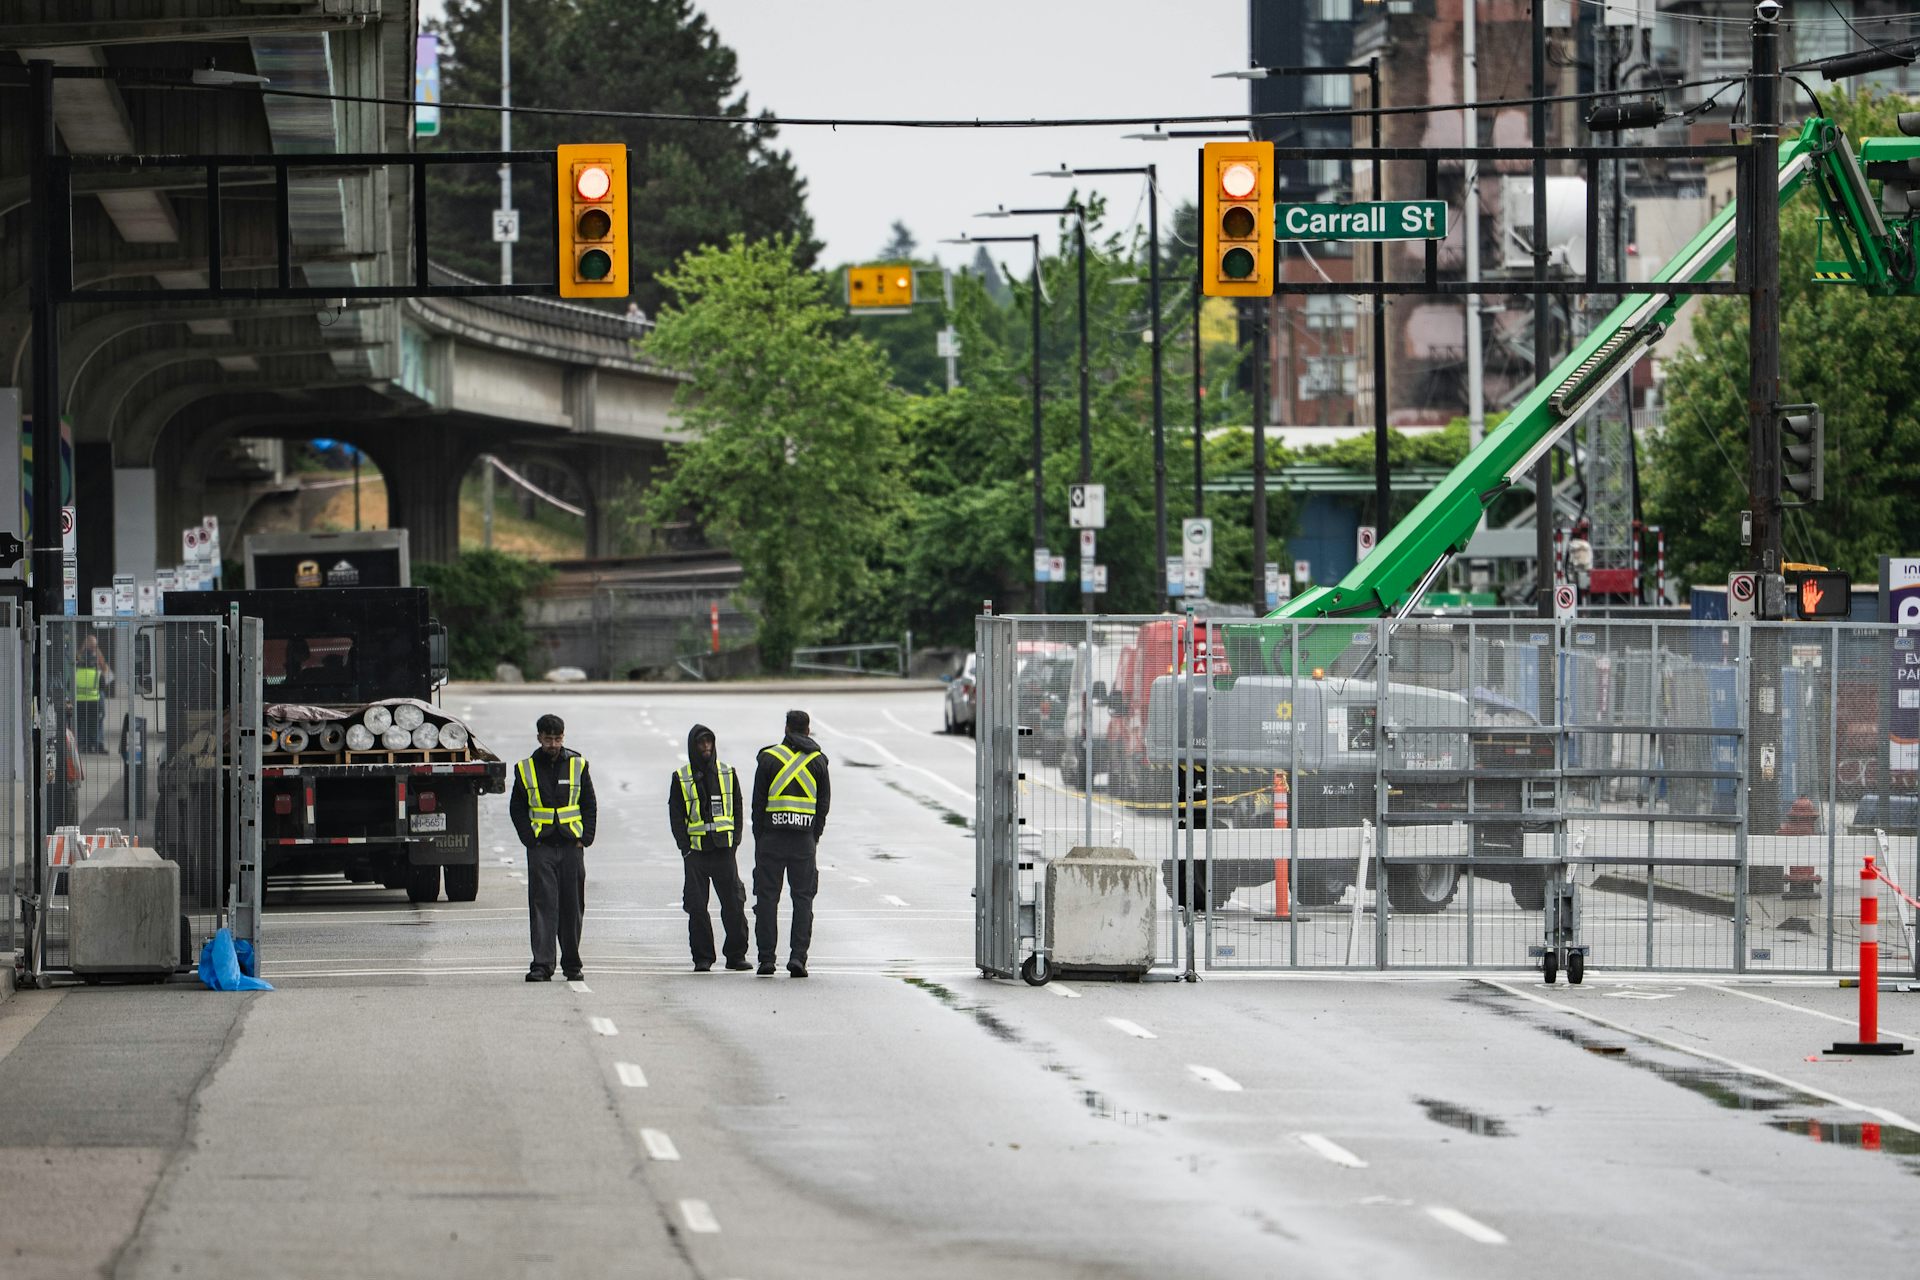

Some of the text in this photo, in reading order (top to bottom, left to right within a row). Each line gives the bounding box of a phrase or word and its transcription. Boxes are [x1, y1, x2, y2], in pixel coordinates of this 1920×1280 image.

[1286, 205, 1435, 234] Carrall St
[772, 812, 813, 826] SECURITY
